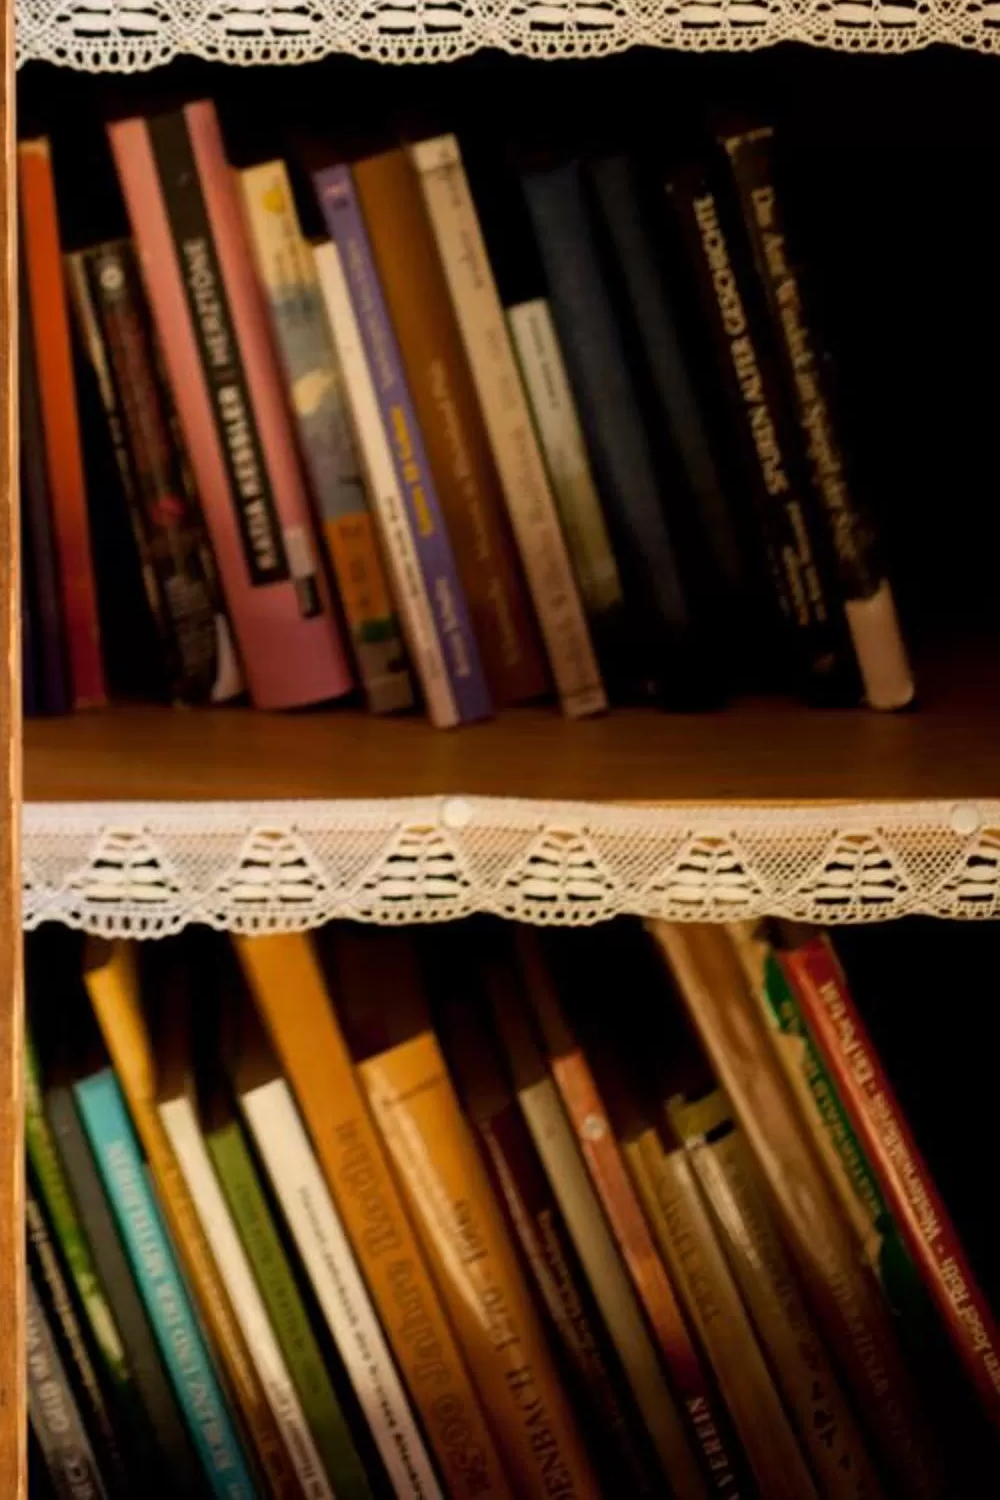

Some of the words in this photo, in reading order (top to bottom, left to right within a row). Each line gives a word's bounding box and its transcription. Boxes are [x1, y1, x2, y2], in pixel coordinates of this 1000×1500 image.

[183, 240, 230, 368] HERZTÖNE
[691, 192, 748, 335] GESCHICHTE
[729, 336, 765, 402] ALTER
[216, 385, 263, 499] KESSLER
[747, 404, 792, 496] SPUREN
[245, 499, 277, 570] KATJA
[935, 1256, 972, 1304] Roth
[956, 1303, 994, 1356] Josef
